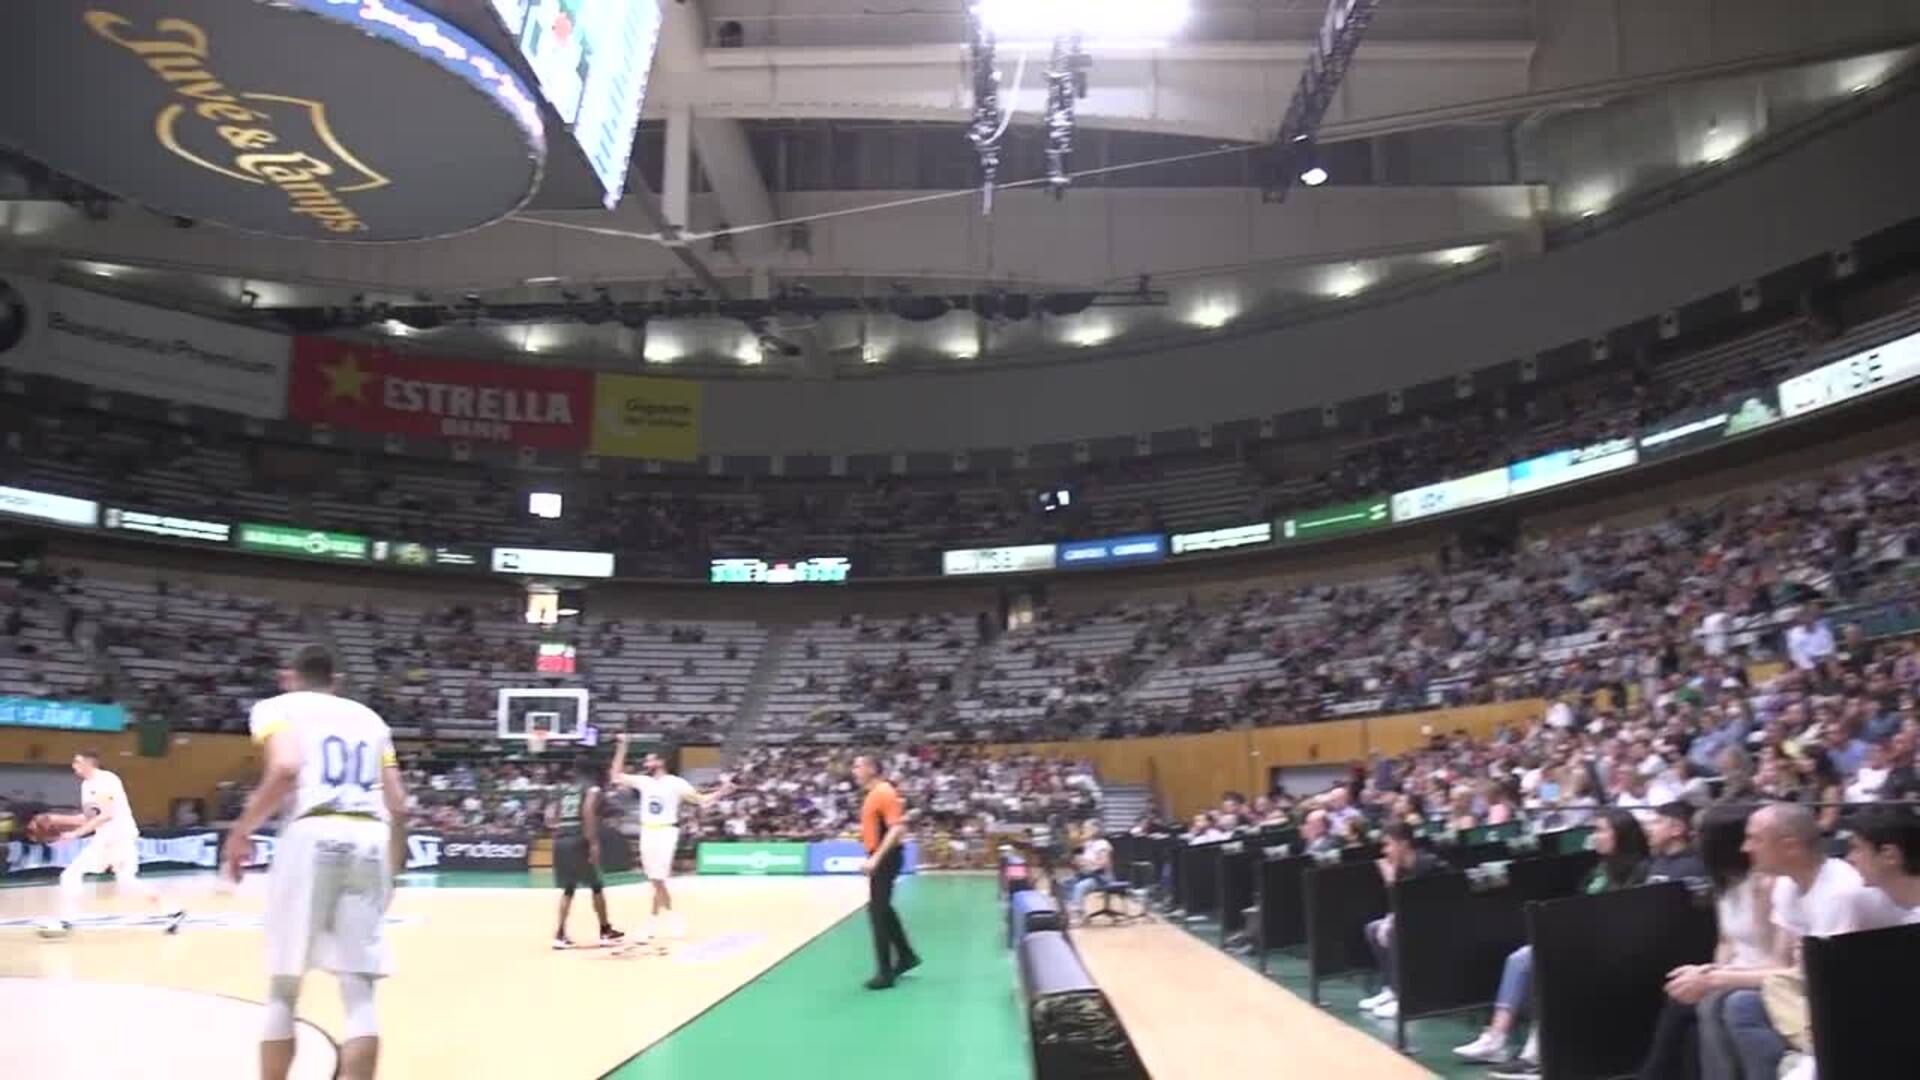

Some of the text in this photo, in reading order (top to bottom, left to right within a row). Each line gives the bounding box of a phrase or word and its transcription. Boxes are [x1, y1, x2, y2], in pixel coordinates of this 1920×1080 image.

[83, 10, 370, 232] Juvé & Camps
[383, 374, 573, 424] ESTRELLA
[444, 841, 527, 858] endesa
